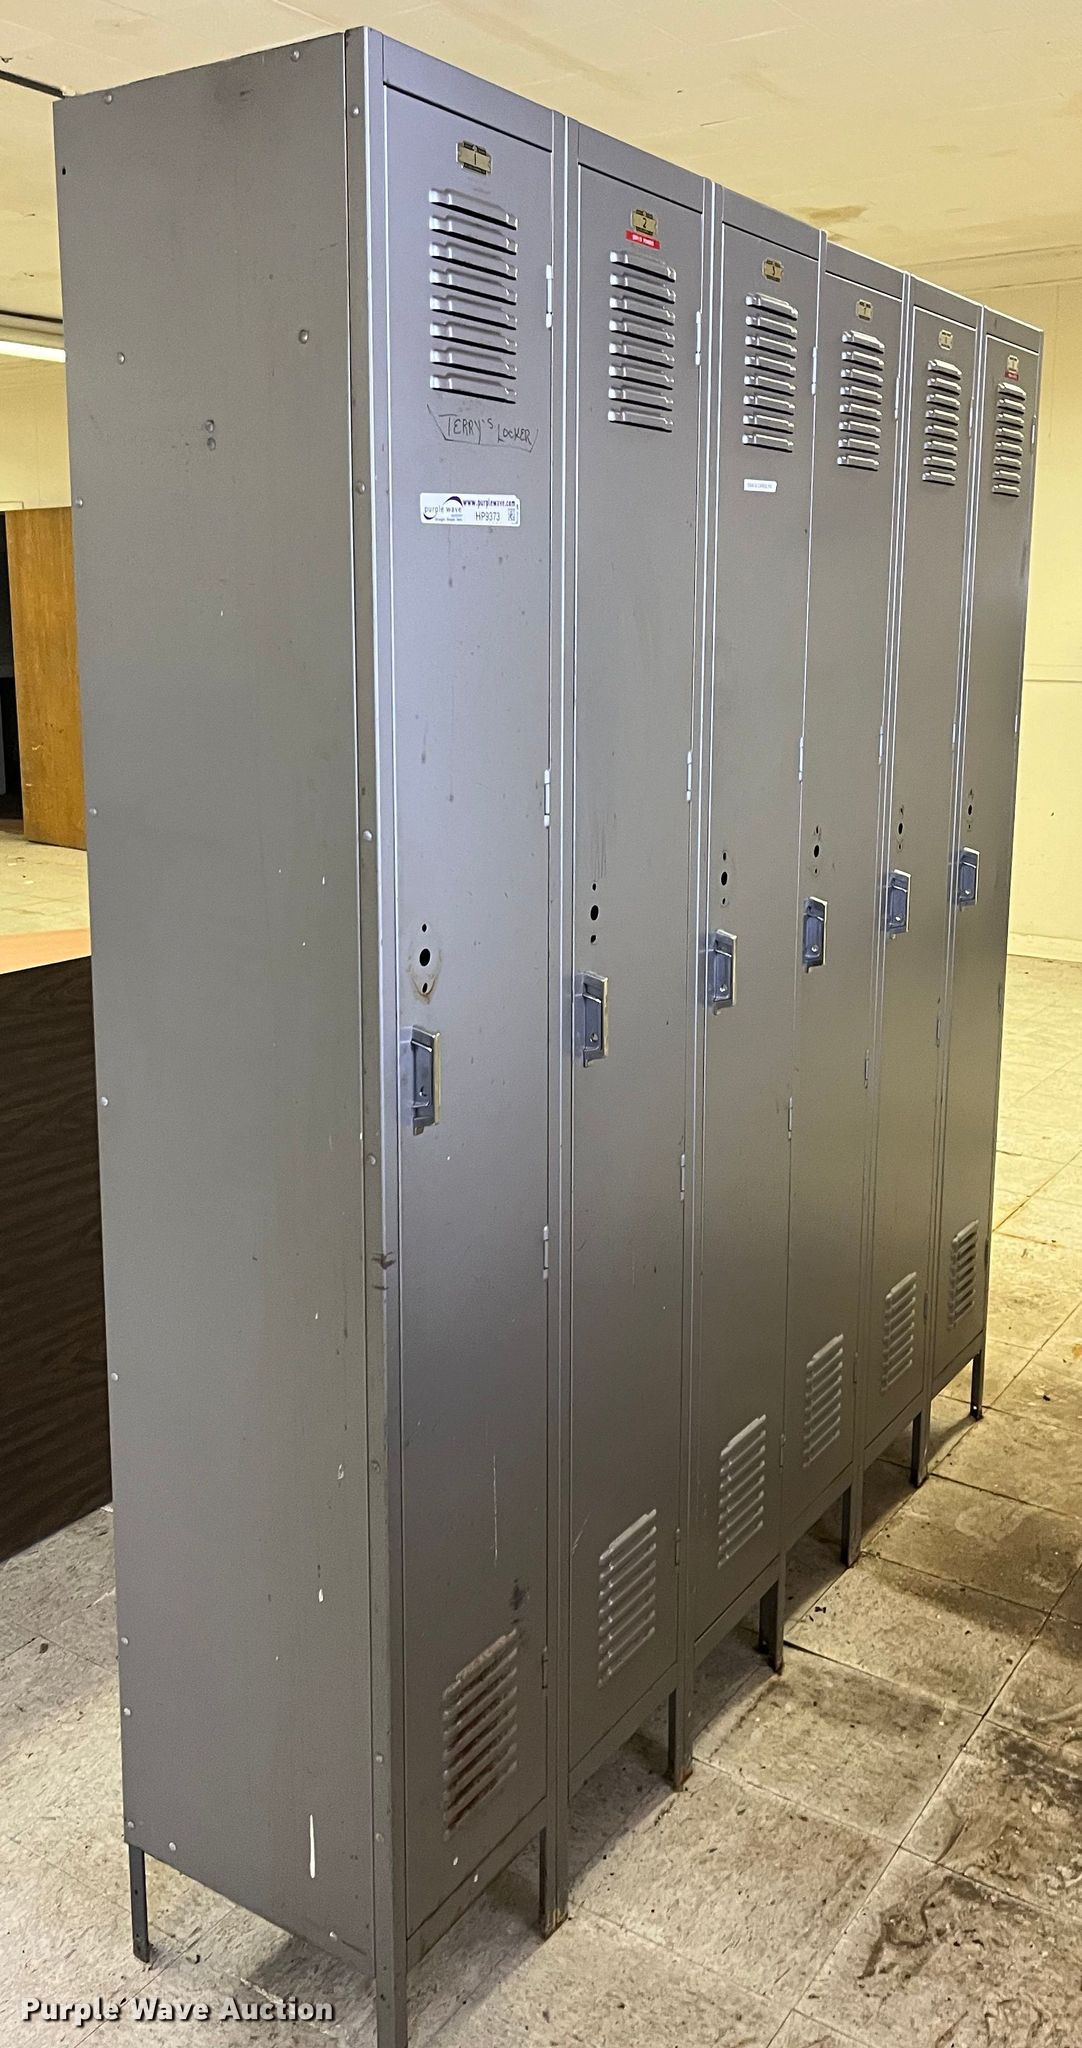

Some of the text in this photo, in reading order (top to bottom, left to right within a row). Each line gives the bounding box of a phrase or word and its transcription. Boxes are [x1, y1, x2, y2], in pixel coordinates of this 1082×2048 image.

[439, 413, 532, 446] TERRY'S LOCKER
[424, 505, 444, 513] purple
